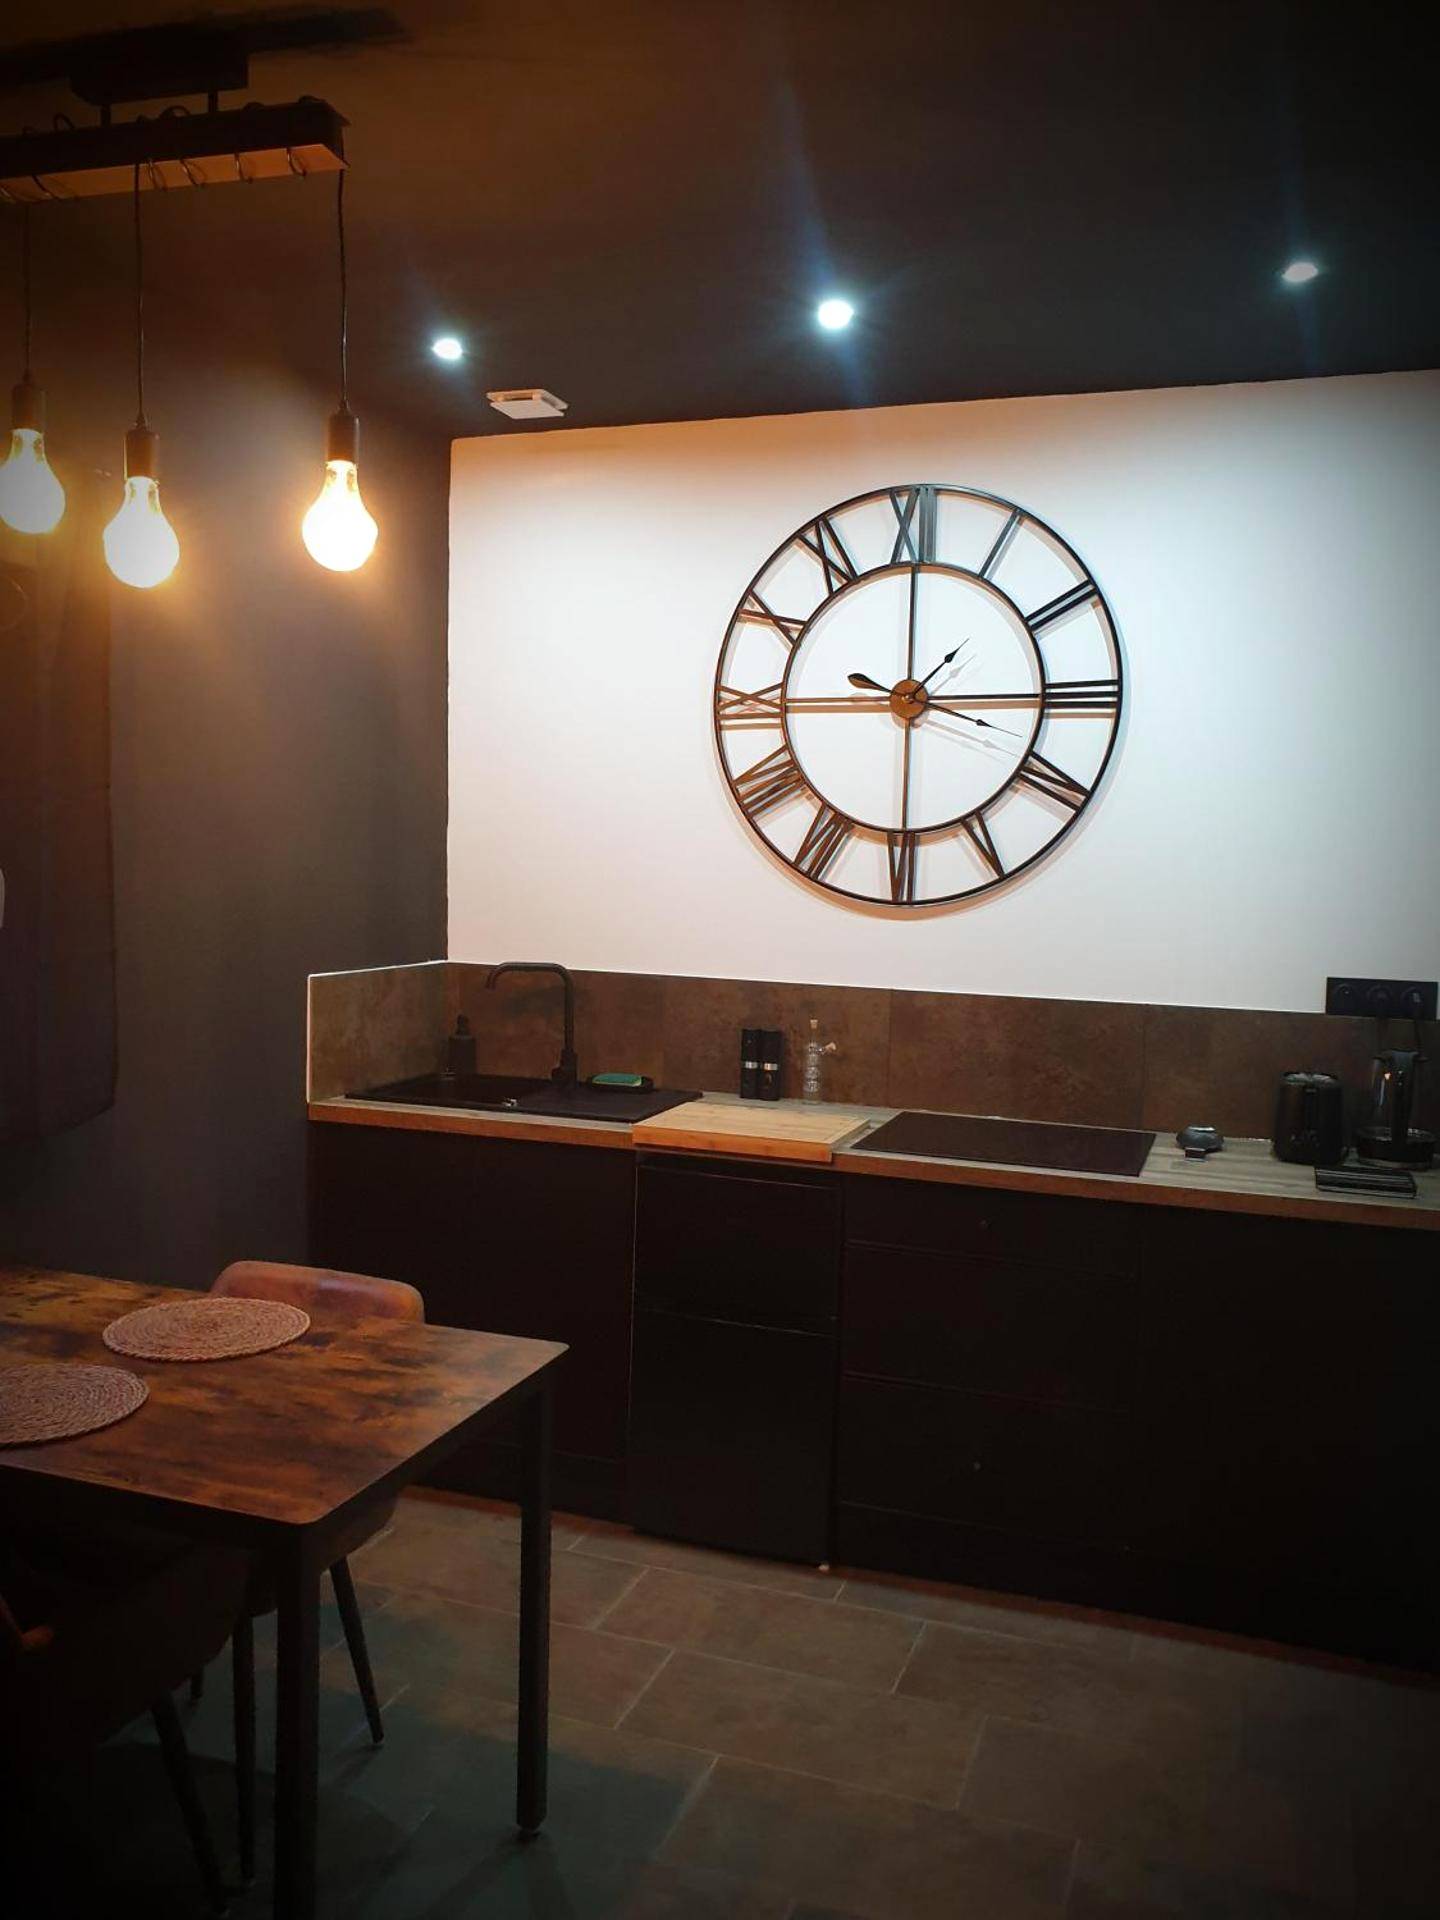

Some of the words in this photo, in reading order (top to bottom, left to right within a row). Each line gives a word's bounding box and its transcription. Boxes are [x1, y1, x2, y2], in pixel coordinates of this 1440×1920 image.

[799, 516, 858, 596] XI
[889, 486, 938, 564] XII
[740, 590, 806, 647] X
[887, 832, 916, 903] VI
[962, 812, 1005, 879] V
